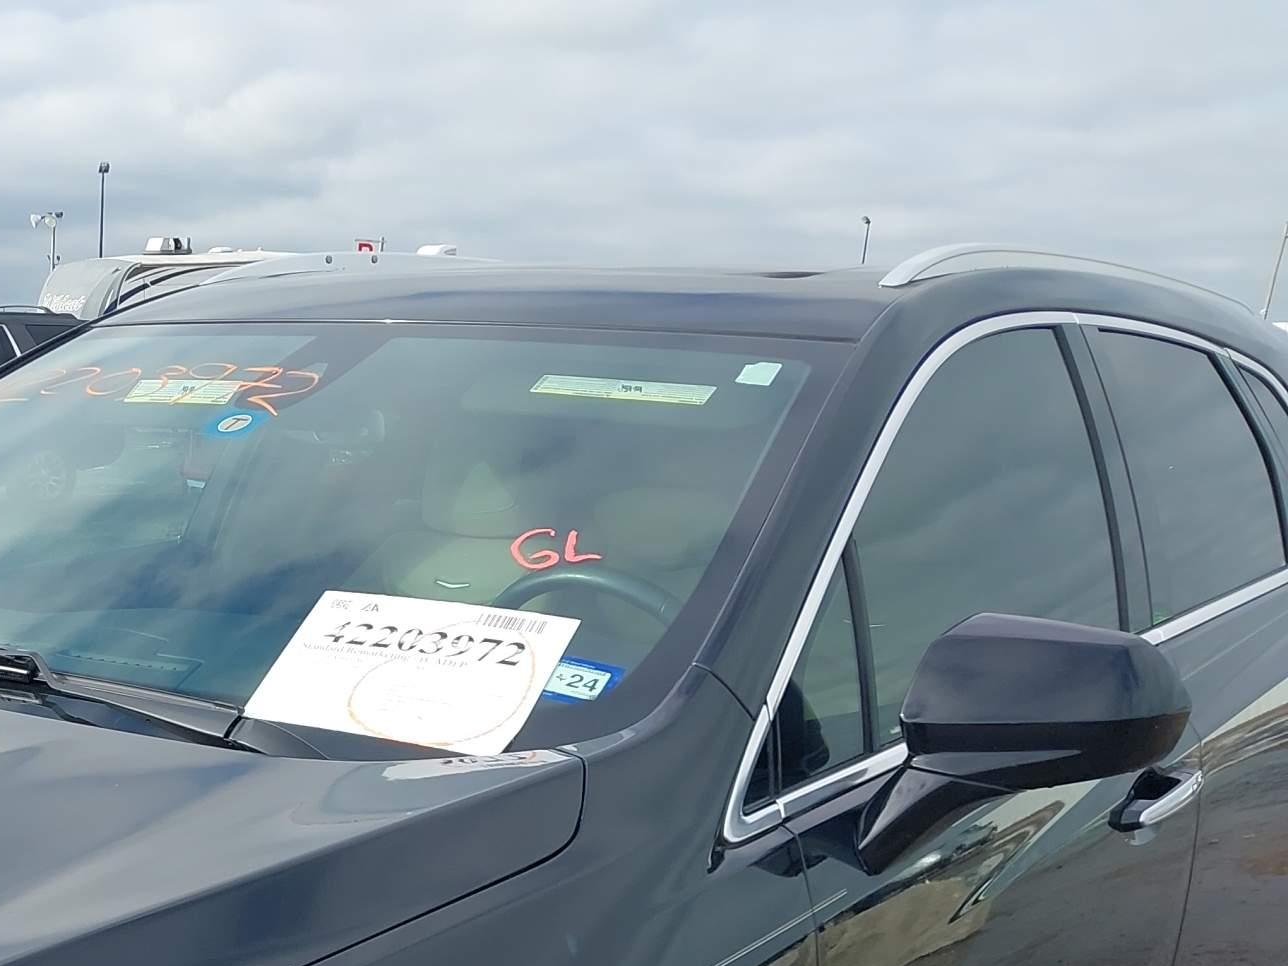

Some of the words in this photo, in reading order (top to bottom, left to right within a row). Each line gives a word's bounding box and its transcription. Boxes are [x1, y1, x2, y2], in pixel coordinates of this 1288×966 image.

[510, 528, 602, 570] GL
[323, 620, 526, 667] 42203972
[566, 674, 600, 692] 24
